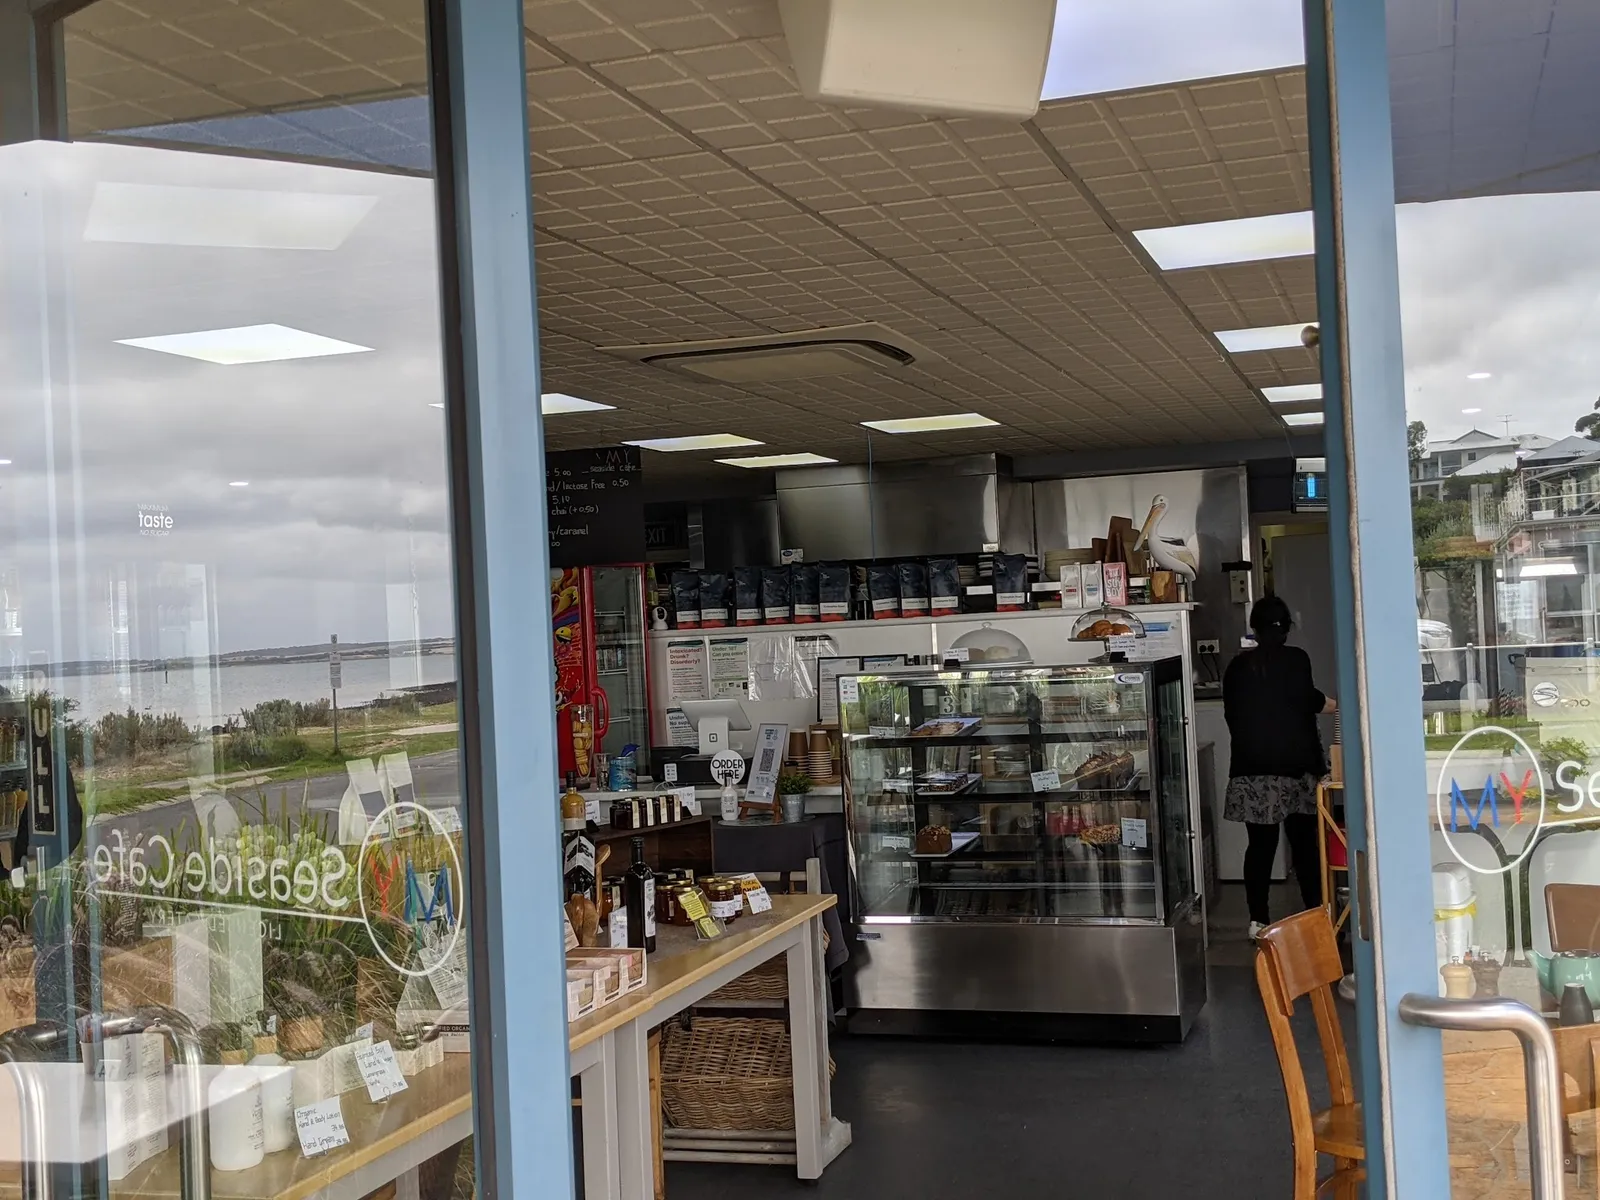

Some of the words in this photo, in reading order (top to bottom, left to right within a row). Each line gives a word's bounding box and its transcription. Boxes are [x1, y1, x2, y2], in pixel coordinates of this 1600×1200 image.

[606, 448, 630, 463] MY
[554, 468, 571, 477] 5.00
[612, 478, 629, 487] 0.50
[552, 495, 570, 504] 5.10
[138, 510, 174, 529] taste
[1106, 587, 1122, 597] BOY
[711, 758, 744, 769] ORDER
[717, 769, 740, 780] HERE
[1451, 769, 1533, 833] MY
[302, 1137, 318, 1149] Hand
